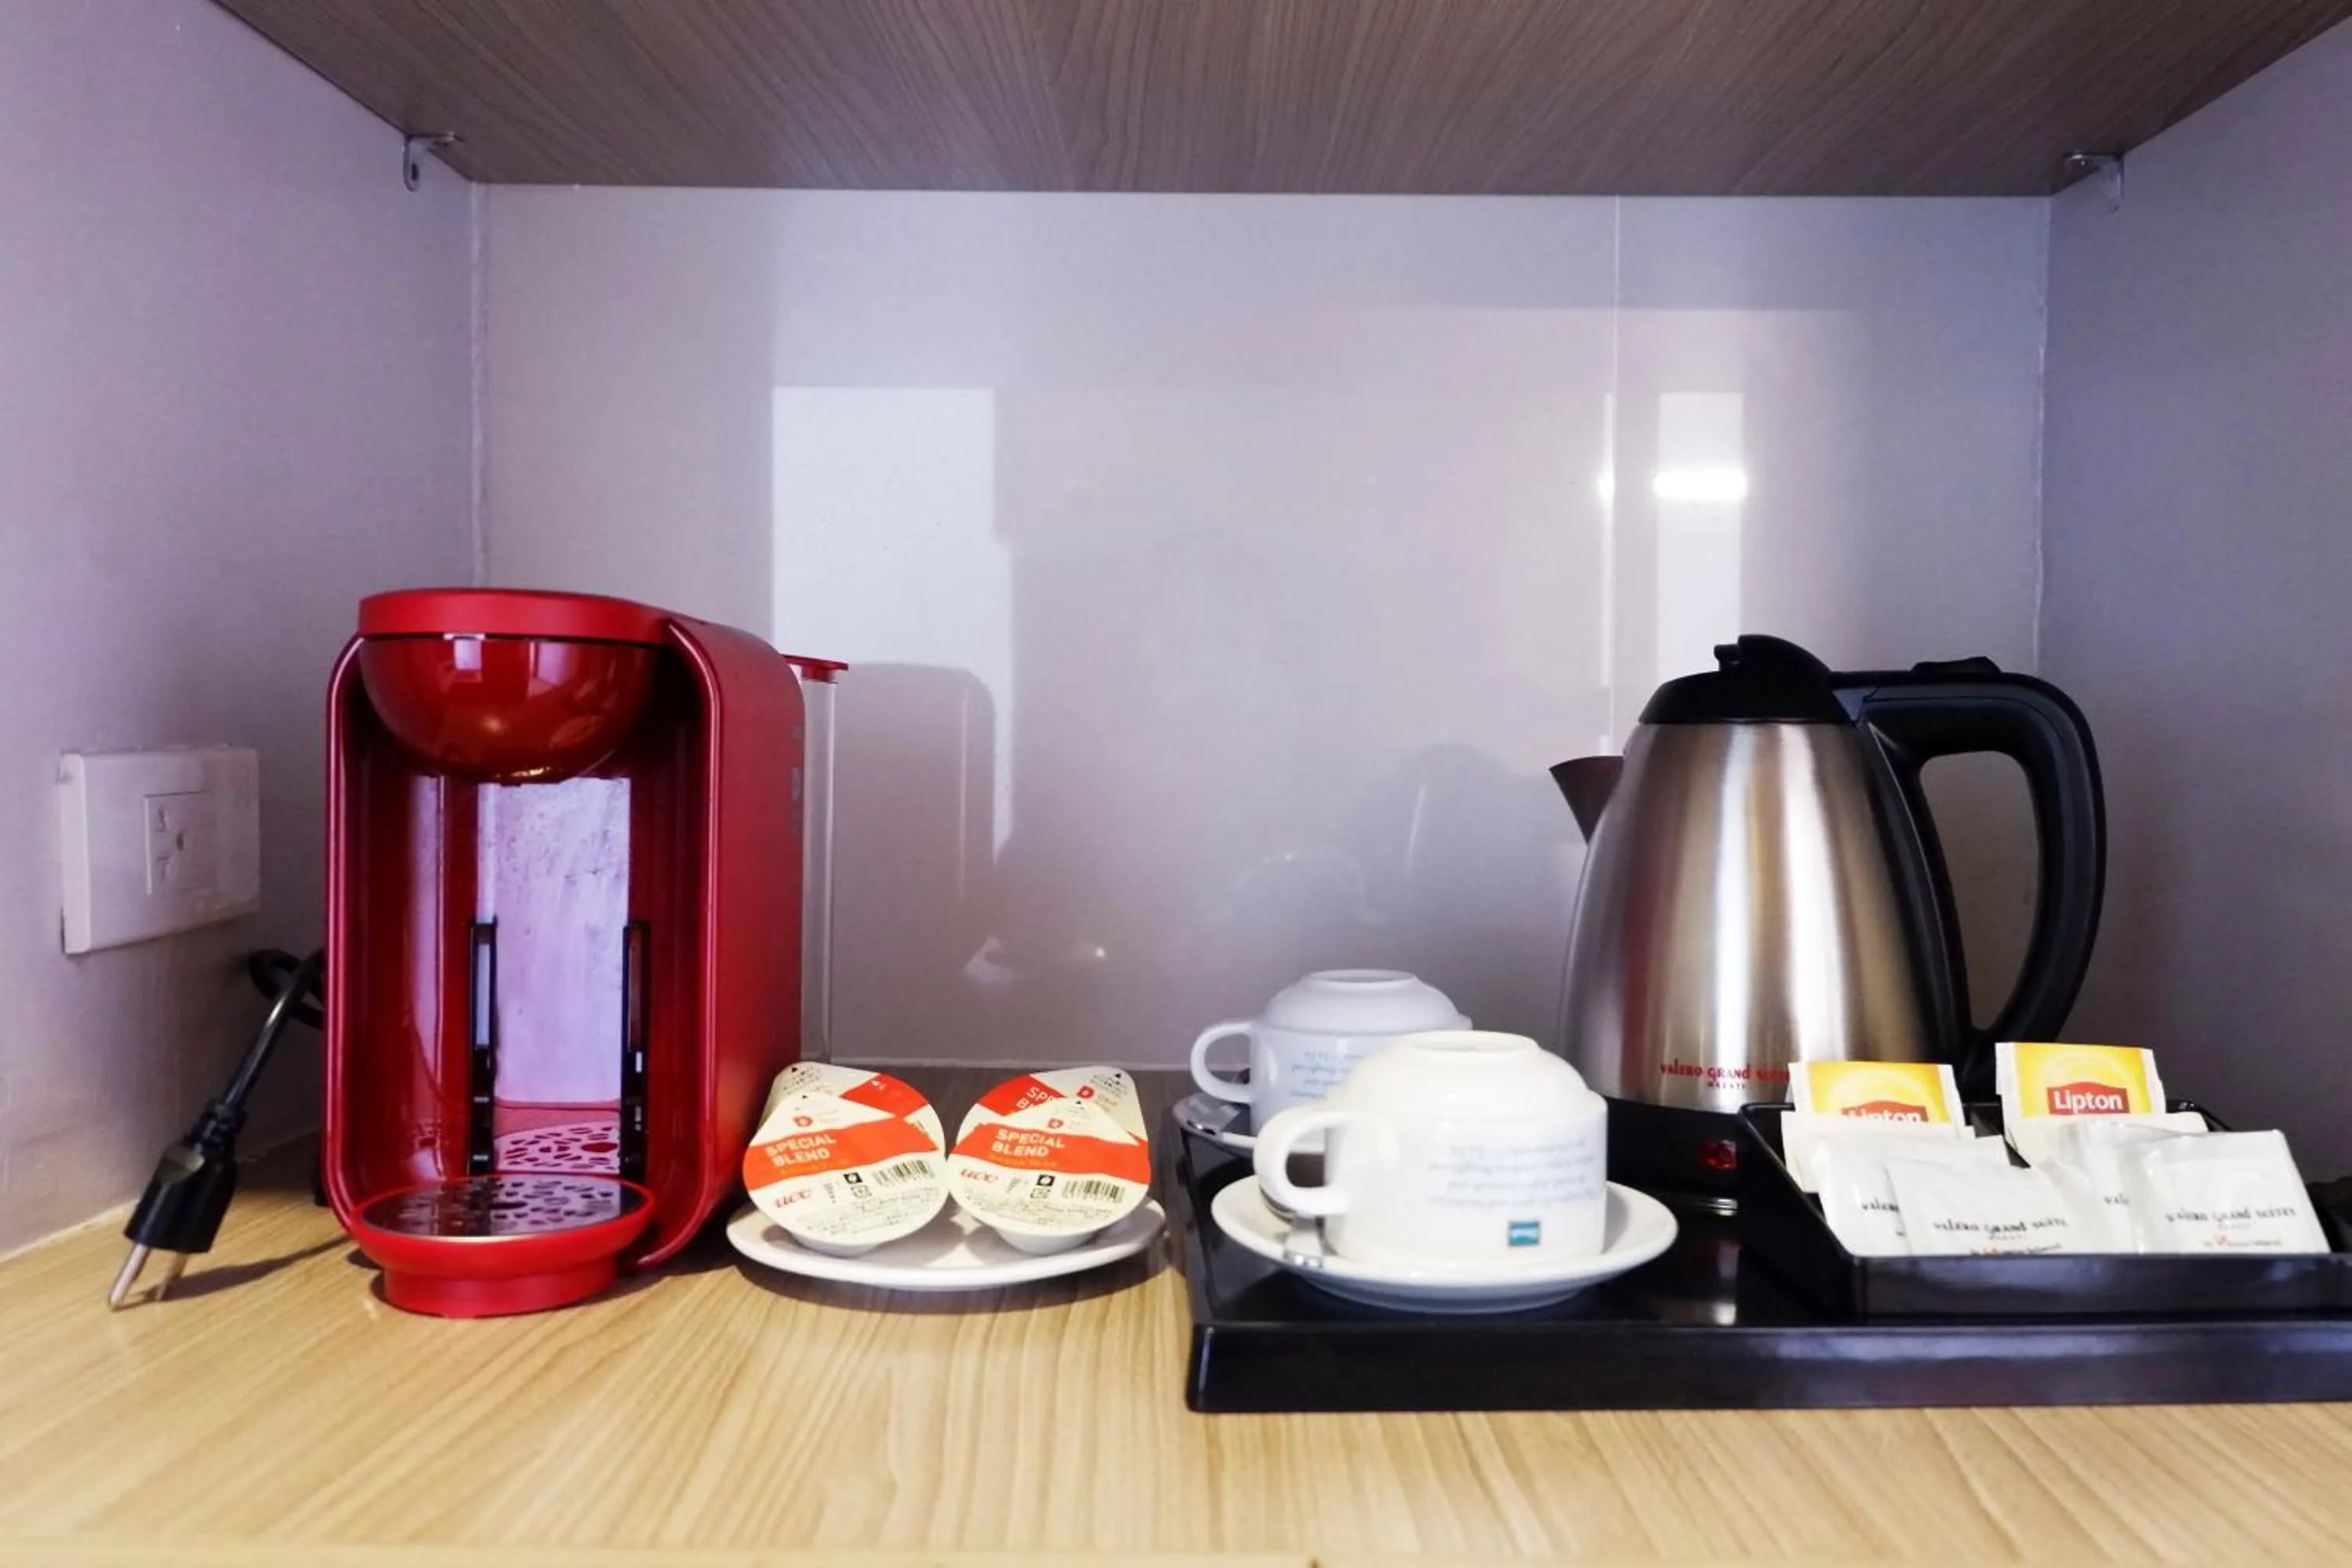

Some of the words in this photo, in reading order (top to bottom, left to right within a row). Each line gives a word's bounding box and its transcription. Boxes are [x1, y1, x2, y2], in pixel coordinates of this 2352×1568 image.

[2053, 1090, 2124, 1114] Lipton
[765, 1133, 837, 1157] SPECIAL
[996, 1128, 1065, 1149] SPECIAL
[771, 1147, 830, 1167] BLEND
[991, 1142, 1050, 1157] BLEND
